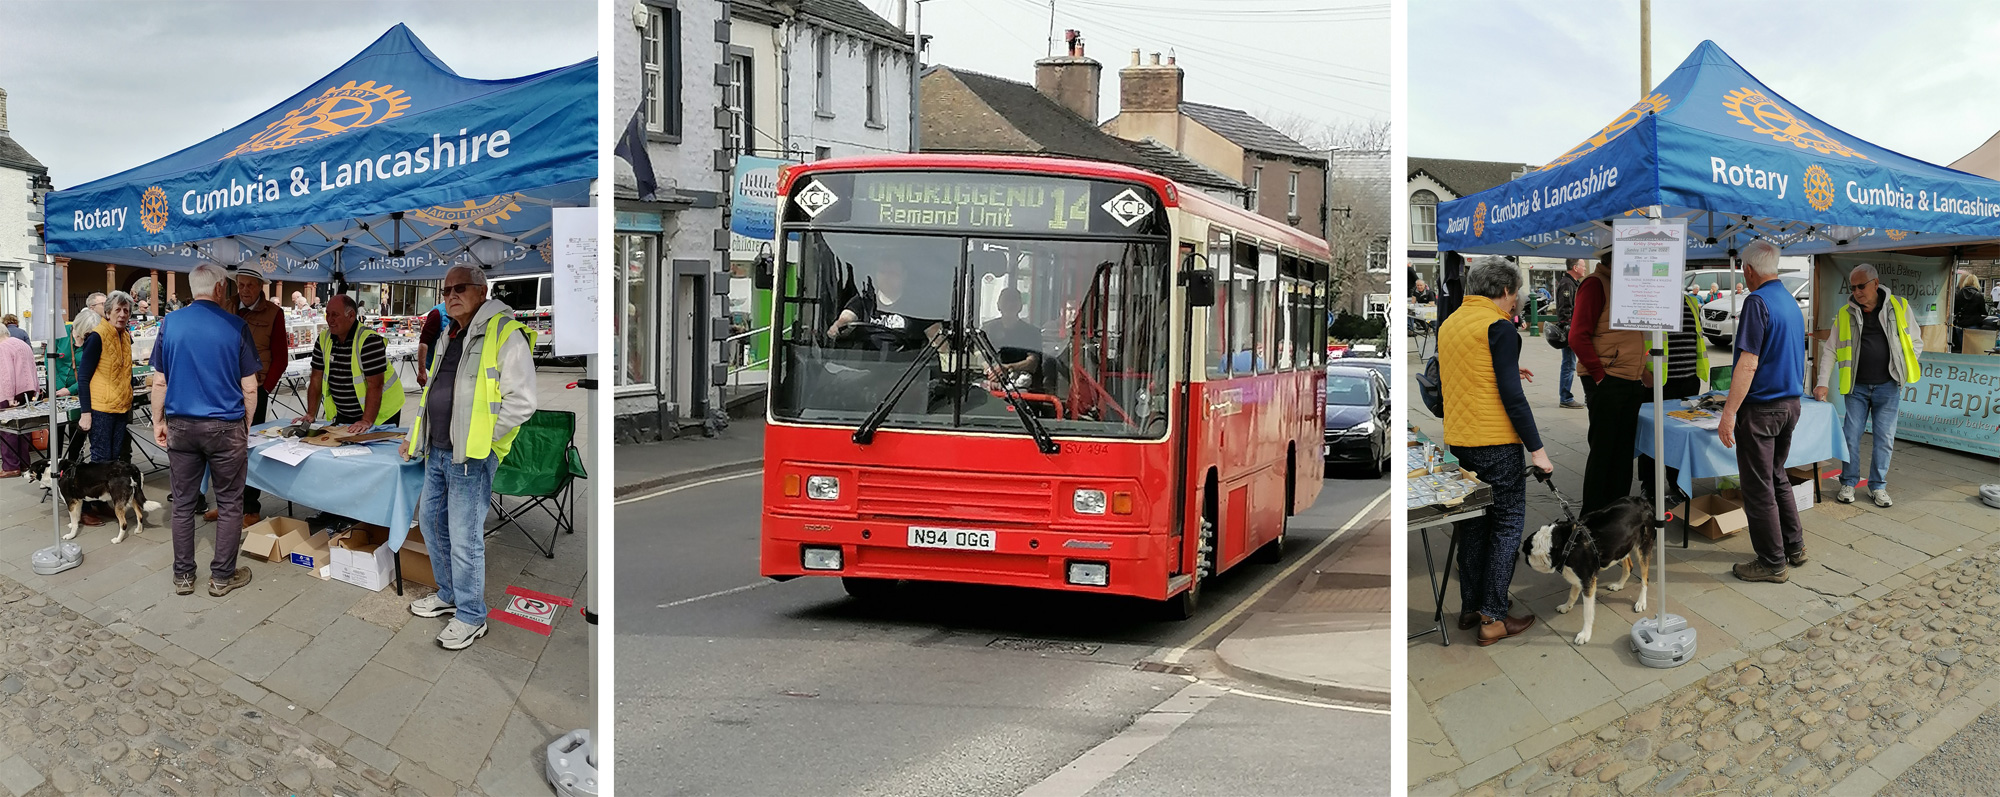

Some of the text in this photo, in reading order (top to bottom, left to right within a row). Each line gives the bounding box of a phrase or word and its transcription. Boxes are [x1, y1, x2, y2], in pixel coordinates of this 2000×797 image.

[181, 174, 281, 216] Cumbria
[289, 166, 311, 197] &
[320, 128, 511, 192] Lancashire
[1710, 156, 1789, 200] Rotary
[800, 192, 831, 205] KCB
[1491, 164, 1618, 225] Cumbria & Lancashire
[1846, 180, 1914, 211] Cumbria
[1917, 190, 1931, 212] &
[1933, 192, 2000, 218] Lancashire
[879, 203, 1014, 228] Remand Unit
[1048, 187, 1090, 232] 14
[1110, 200, 1146, 215] KCB
[73, 206, 128, 232] Rotary
[1446, 215, 1471, 236] Rotary
[1896, 264, 1922, 281] Bakery
[1890, 278, 1939, 300] Flapjack
[1905, 410, 1914, 419] in
[1915, 413, 1932, 422] our
[1932, 415, 1964, 427] family
[1065, 443, 1081, 454] SV
[914, 529, 990, 548] N94 OGG
